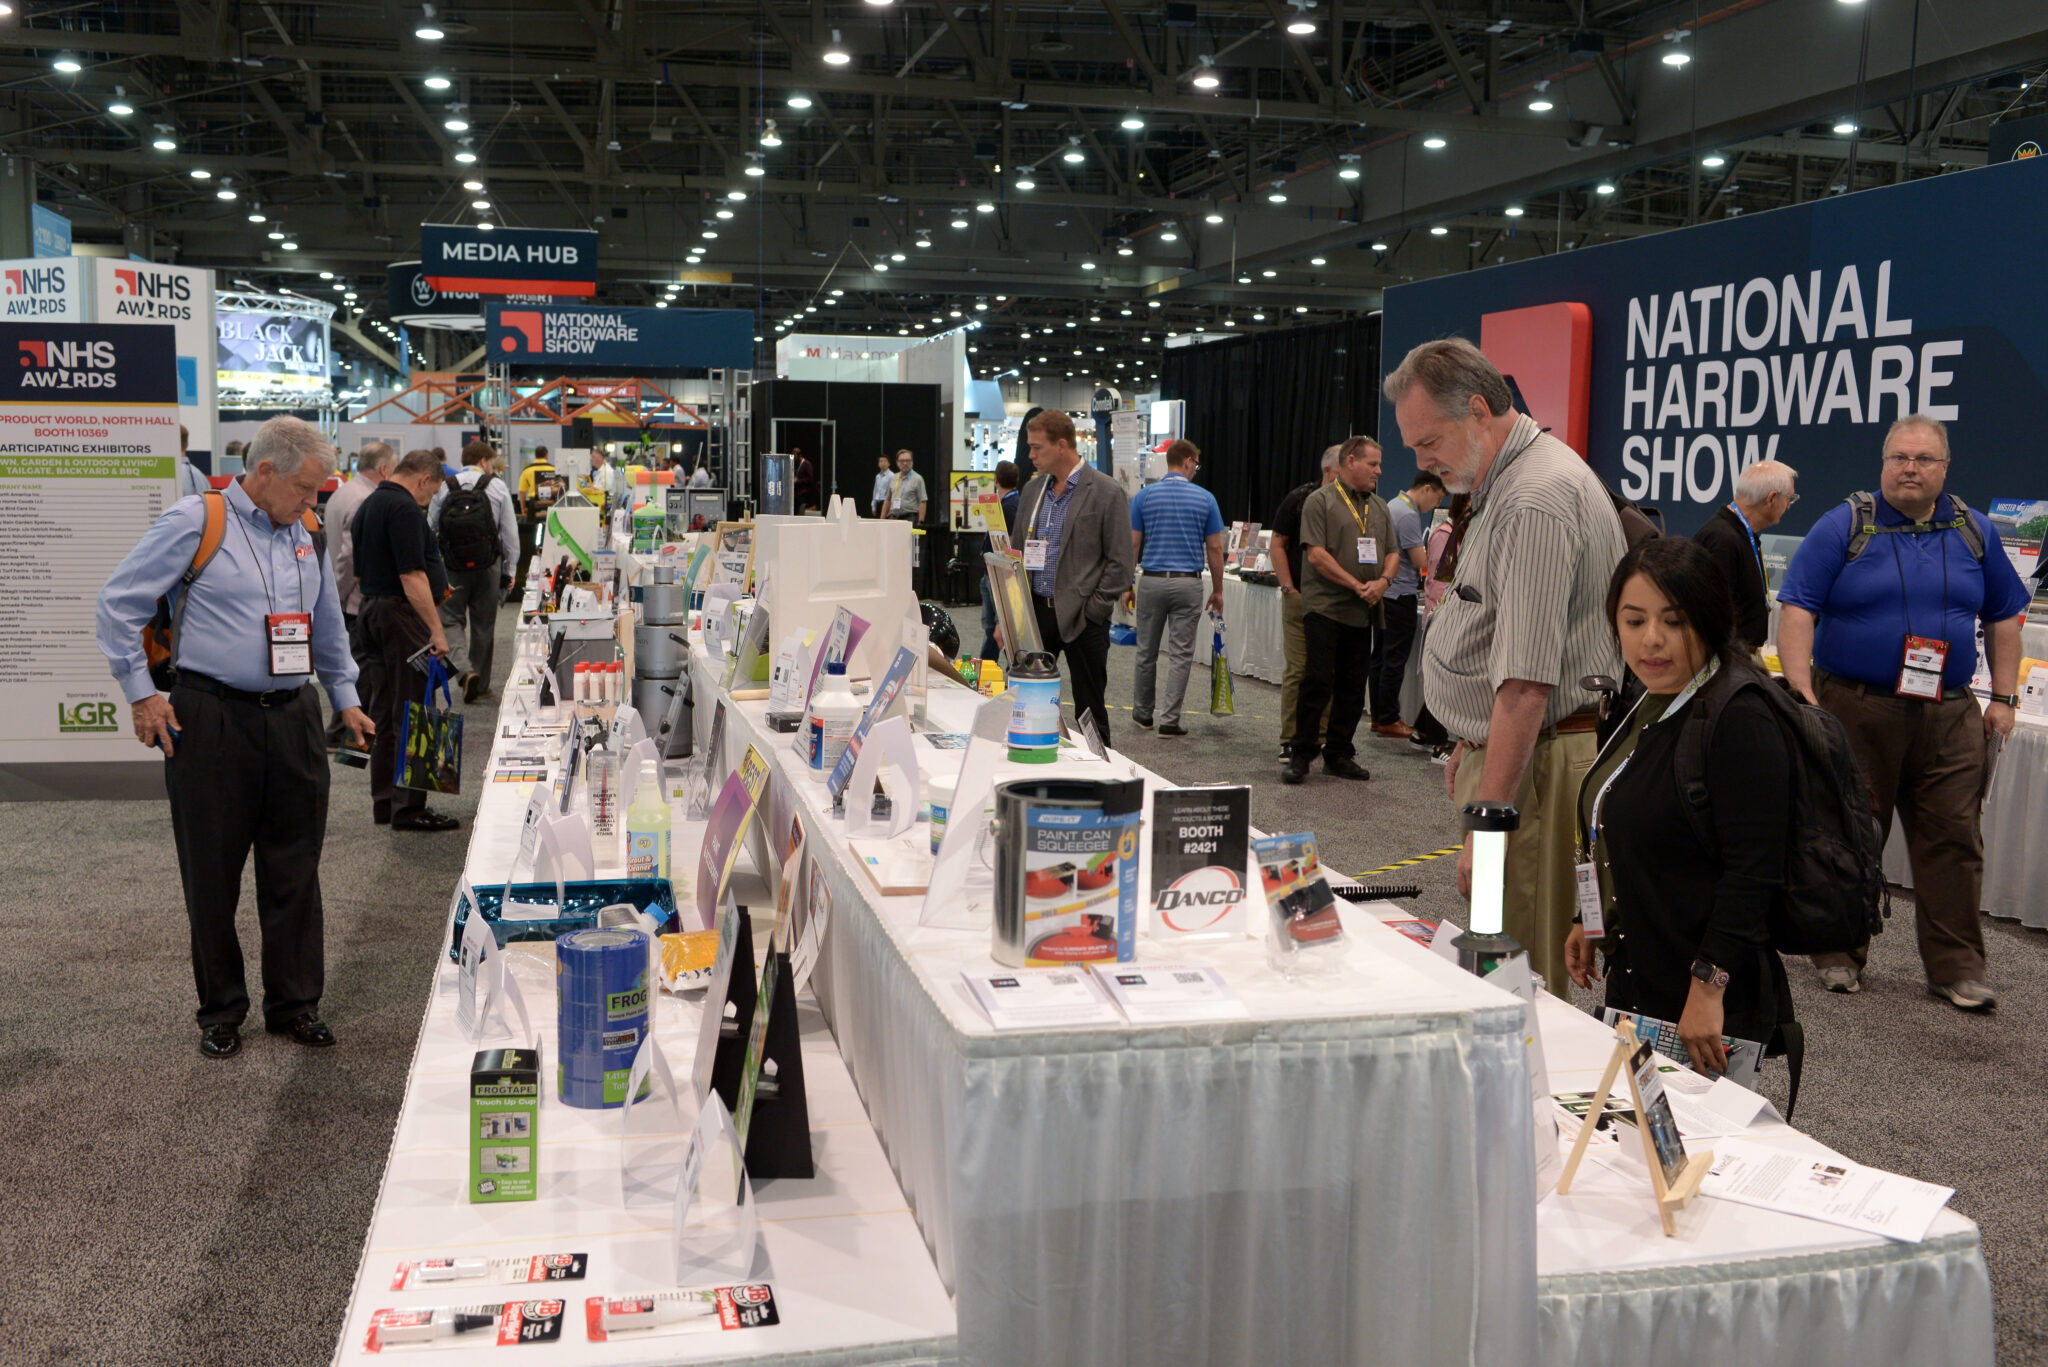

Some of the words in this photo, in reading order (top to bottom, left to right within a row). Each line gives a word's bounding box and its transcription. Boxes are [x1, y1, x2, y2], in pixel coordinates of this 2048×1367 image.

[442, 242, 520, 262] MEDIA
[526, 246, 578, 264] HUB
[22, 266, 65, 294] NHS
[136, 274, 190, 300] NHS
[1626, 259, 1912, 361] NATIONAL
[545, 313, 626, 329] NATIONAL
[220, 321, 293, 344] BLACK
[545, 326, 638, 342] HARDWARE
[48, 340, 116, 368] NHS
[255, 342, 304, 363] JACK
[546, 338, 596, 354] SHOW
[1623, 340, 1963, 430] HARDWARE
[0, 416, 51, 424] PRODUCT
[55, 416, 100, 425] WORLD,
[103, 416, 142, 425] NORTH
[145, 417, 174, 426] HALL
[34, 429, 74, 437] BOOTH
[78, 429, 108, 437] 10369
[82, 445, 152, 453] EXHIBITORS
[1620, 434, 1780, 504] SHOW
[1038, 830, 1078, 840] PAINT
[1082, 830, 1111, 840] CAN
[1179, 826, 1223, 838] BOOTH
[1038, 840, 1108, 851] SQUEEGEE
[1184, 842, 1216, 854] #2421
[1156, 890, 1244, 910] DANCO
[612, 990, 647, 1009] FROG
[478, 1086, 532, 1094] FROGTAPE
